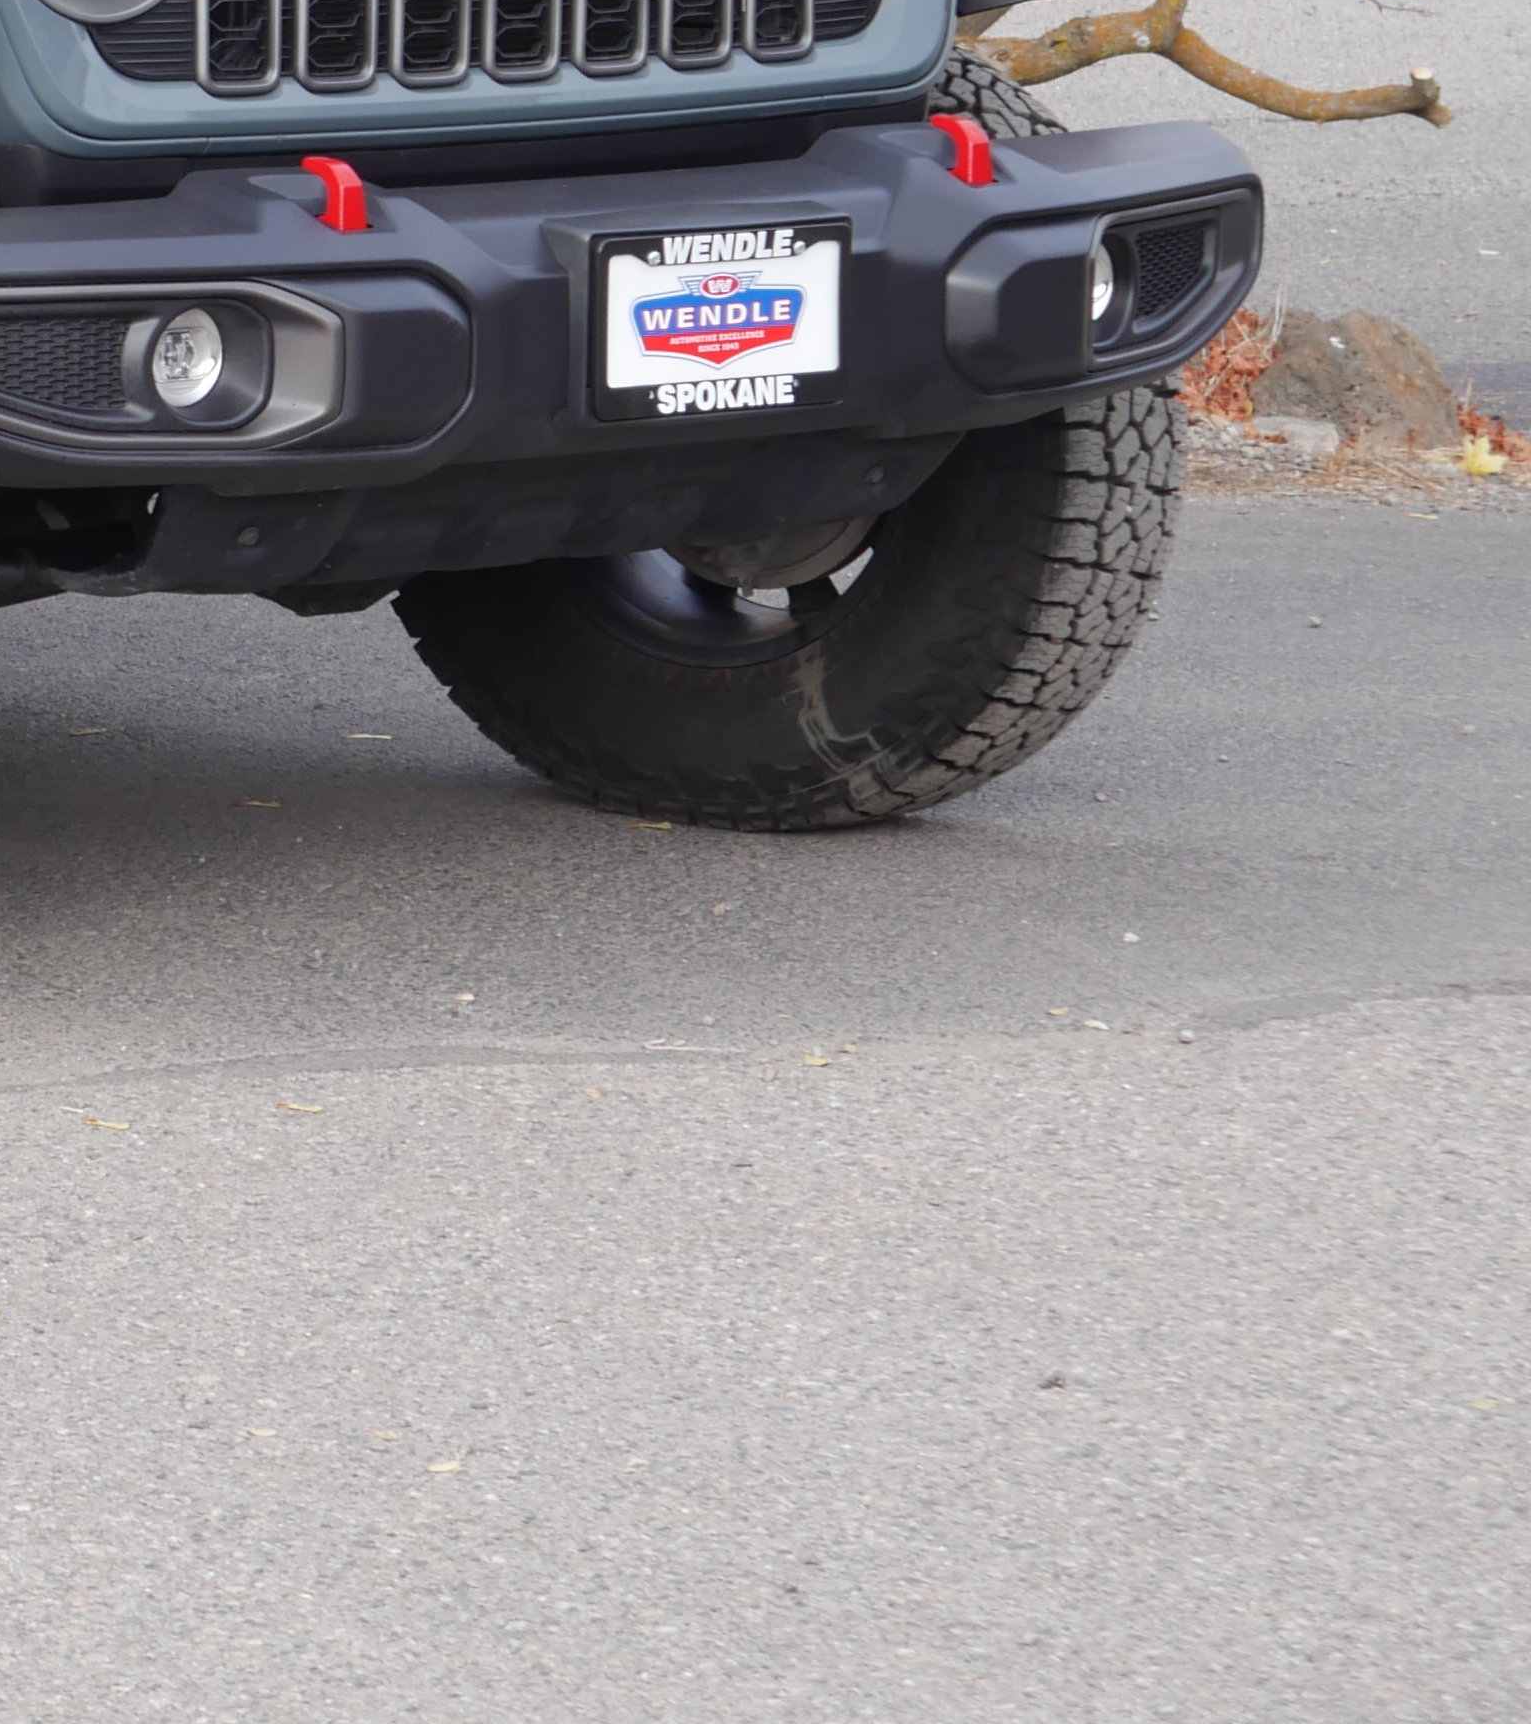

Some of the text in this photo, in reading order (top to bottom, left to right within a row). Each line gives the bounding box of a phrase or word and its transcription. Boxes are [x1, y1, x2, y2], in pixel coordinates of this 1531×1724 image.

[663, 229, 795, 265] WENDLE
[707, 279, 733, 293] W
[643, 300, 792, 330] WENDLE
[669, 330, 765, 345] AUTOMOTIVE EXCELLENCE
[697, 343, 721, 353] SINCE
[657, 375, 795, 414] SPOKANE
